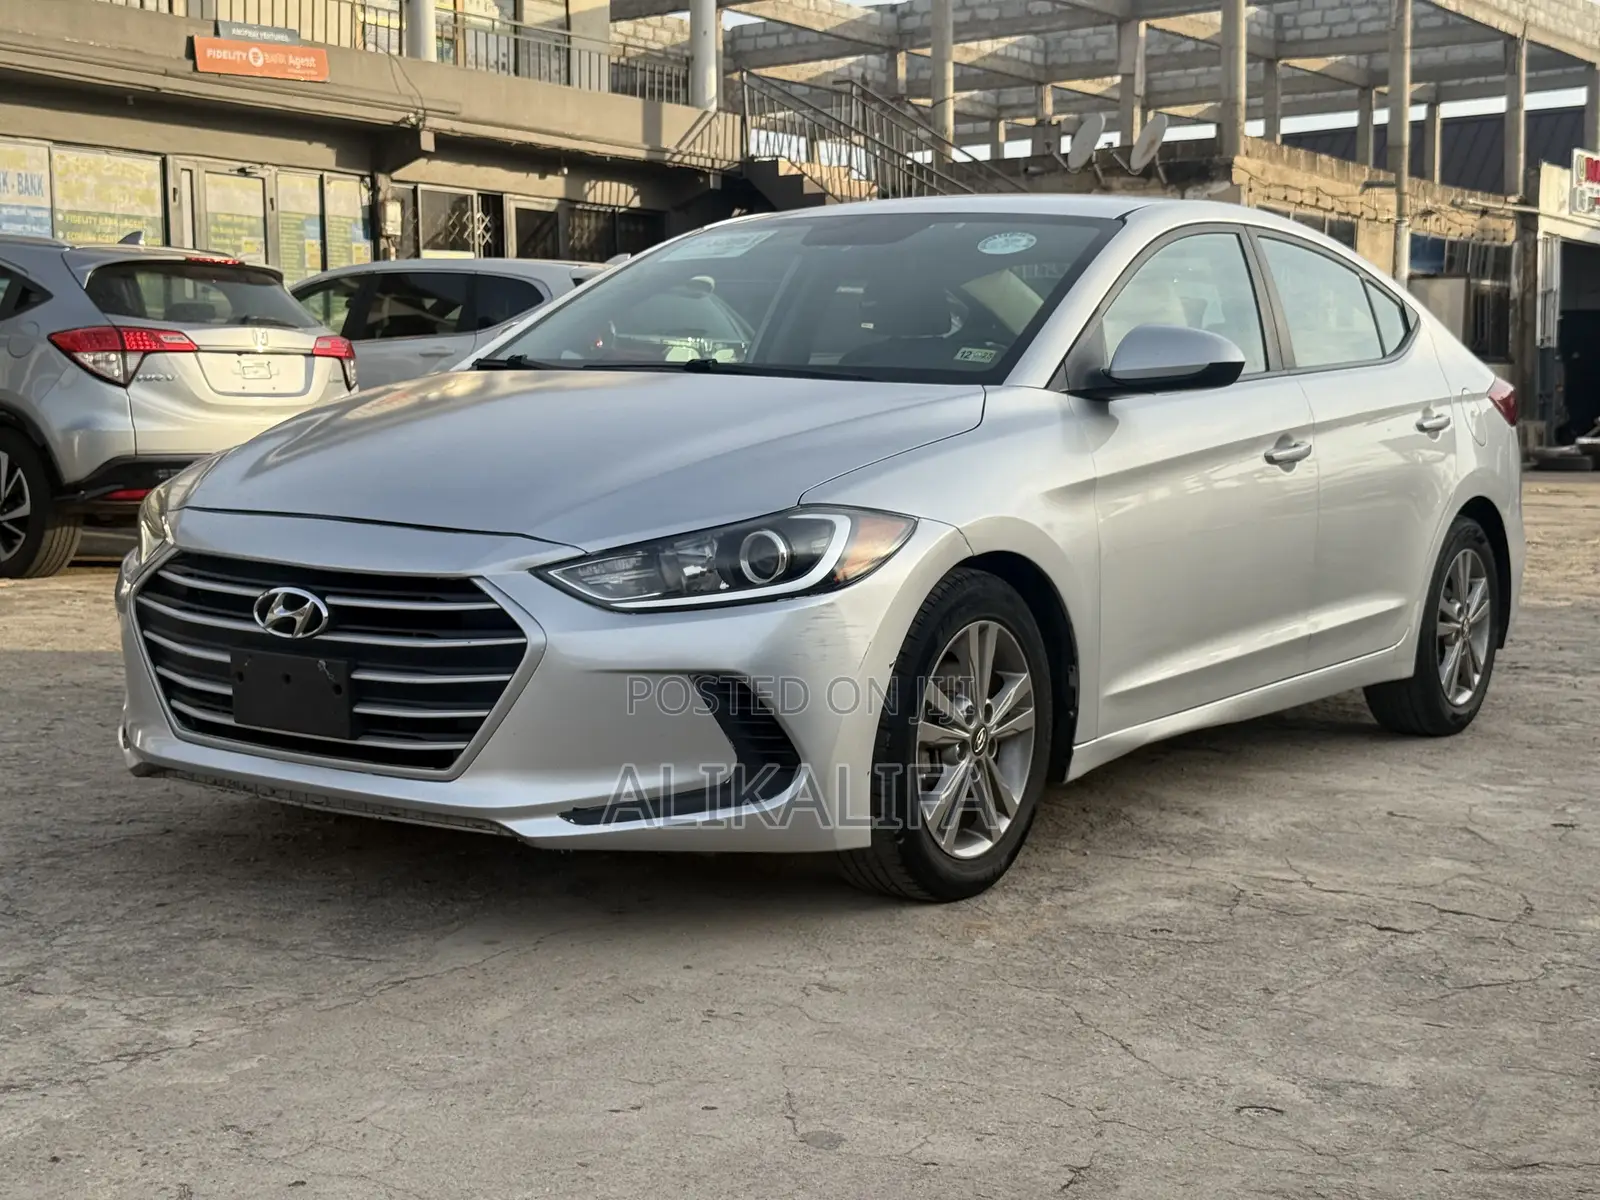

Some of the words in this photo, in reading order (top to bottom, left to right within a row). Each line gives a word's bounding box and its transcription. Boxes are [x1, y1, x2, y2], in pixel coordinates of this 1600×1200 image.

[206, 47, 247, 62] FIDELITY
[17, 172, 44, 197] BANK
[960, 350, 973, 360] 12
